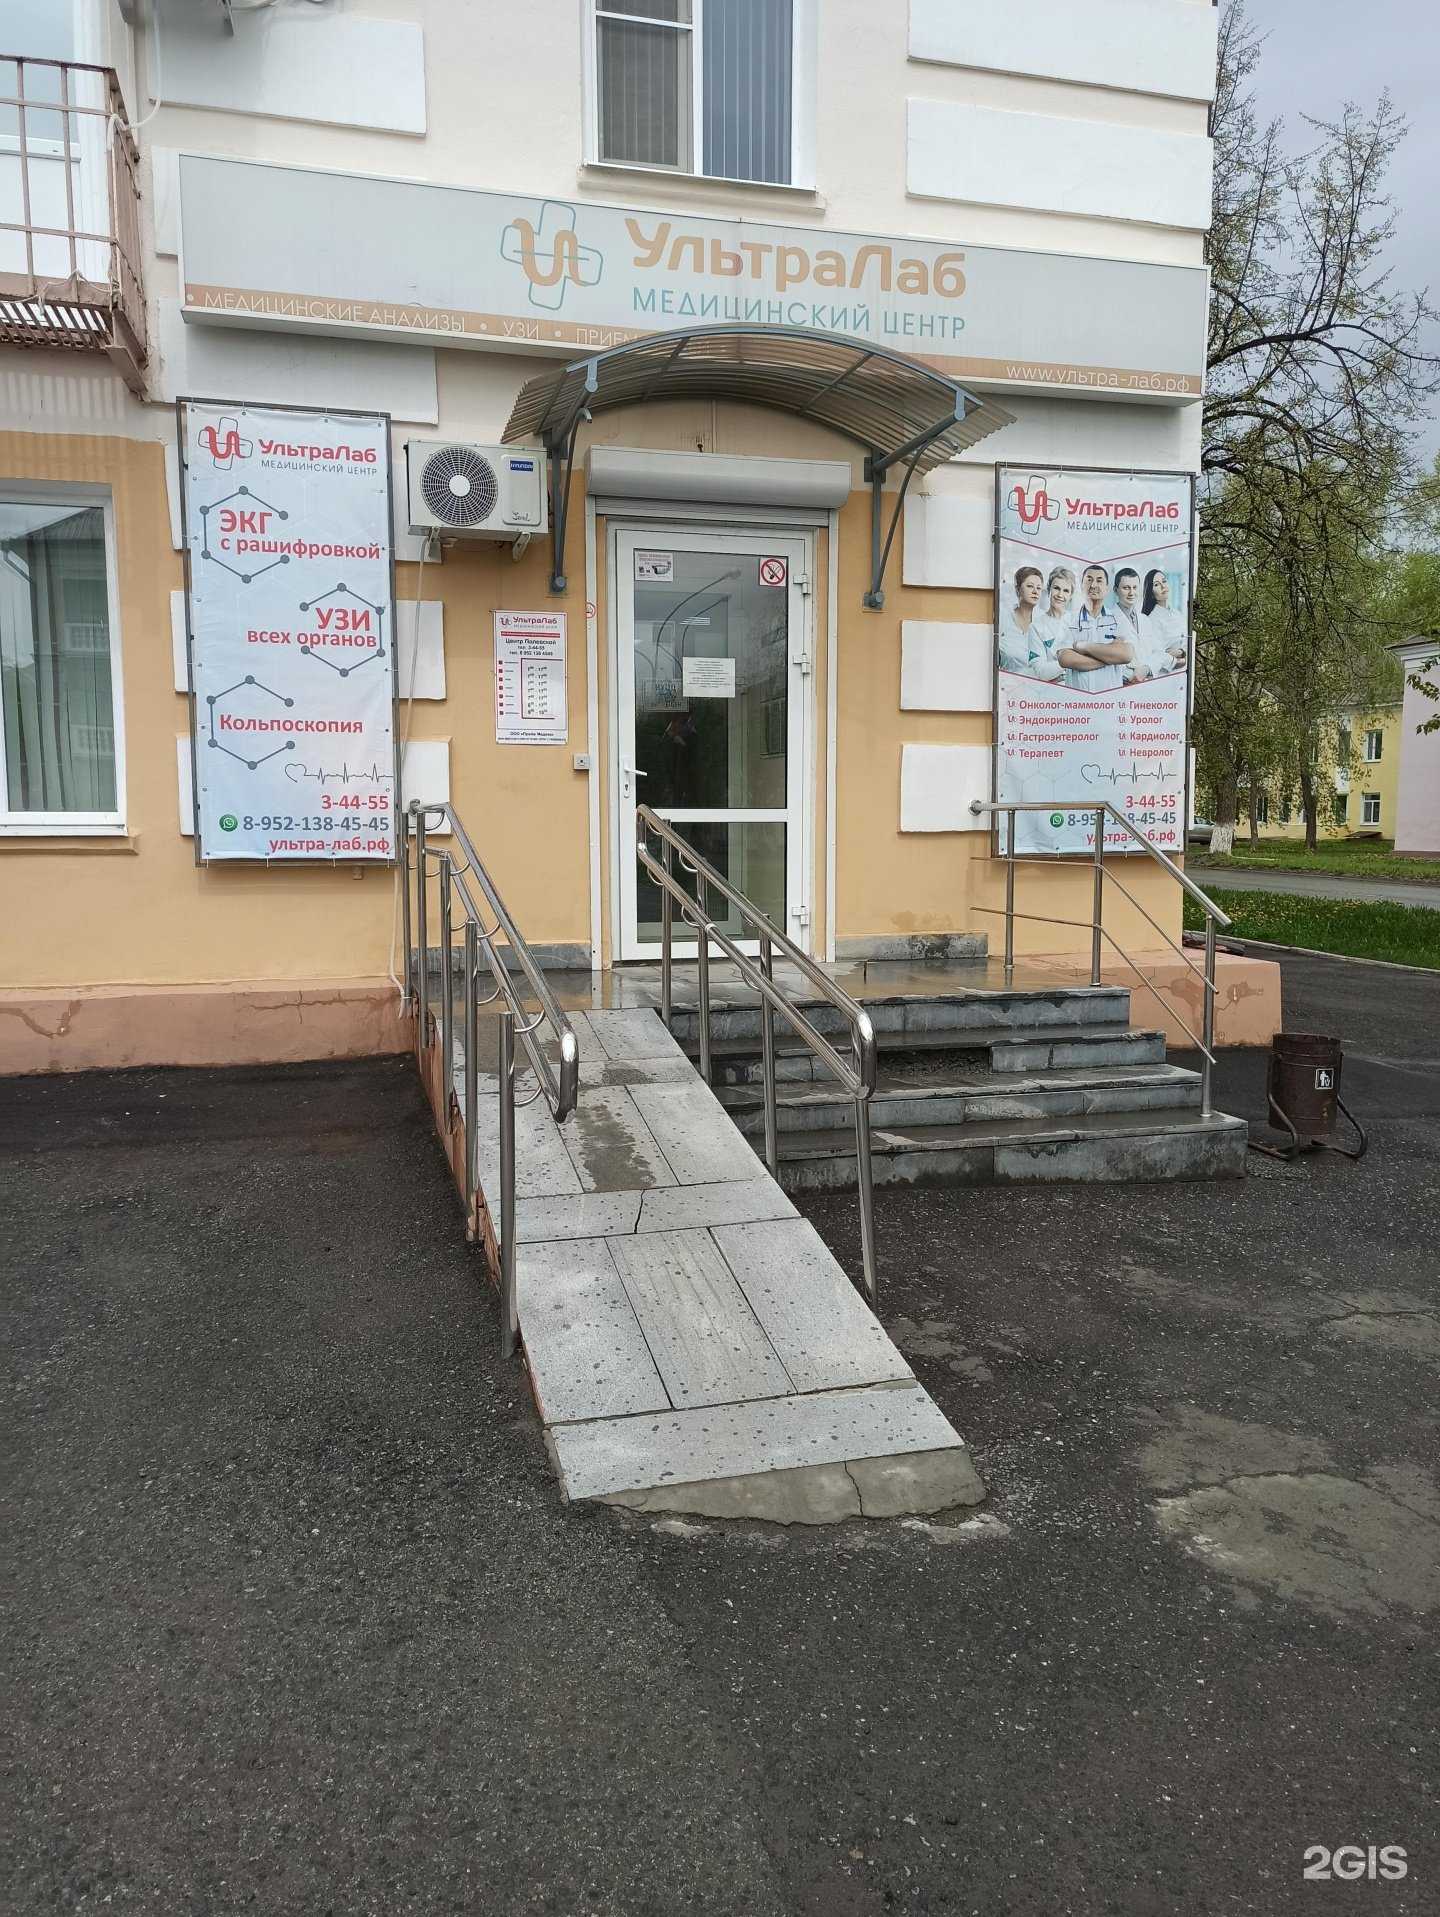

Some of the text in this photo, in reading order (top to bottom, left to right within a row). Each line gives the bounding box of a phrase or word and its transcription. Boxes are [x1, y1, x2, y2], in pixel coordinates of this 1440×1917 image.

[624, 218, 966, 298] УльтраЛаб
[204, 291, 363, 321] МЕДИЦИНСКИЕ
[368, 308, 465, 333] АНАЛИЗЫ
[503, 320, 539, 340] УЗИ
[632, 286, 966, 339] МЕДИЦИНСКИЙ ЦЕНТР
[1006, 364, 1191, 394] www.ультра-лаб.рф
[258, 438, 377, 463] УльтраЛаб
[261, 459, 378, 476] МЕДИЦИНСКИЙ ЦЕНТР
[1065, 497, 1179, 520] УльтраЛаб
[219, 509, 273, 534] ЭКГ
[1067, 520, 1179, 533] МЕДИЦИНСКИЙ ЦЕНТР
[220, 538, 380, 560] с рашифровкой
[315, 607, 371, 632] УЗИ
[247, 630, 377, 648] всех органов
[1019, 700, 1115, 710] Онколог-маммолог
[1129, 700, 1178, 710] Гинеколог
[219, 714, 363, 734] Кольпоскопия
[1019, 715, 1091, 726] Эндокринолог
[1130, 715, 1163, 725] Уролог
[1018, 732, 1099, 743] Гастроэнтеролог
[1130, 731, 1180, 742] Кардиолог
[1019, 749, 1065, 759] Терапевт
[1129, 748, 1174, 759] Невролог
[321, 794, 389, 810] 3-44-55
[1125, 794, 1176, 809] 3-44-55
[242, 815, 390, 832] 8-952-138-45-45
[1067, 812, 1177, 827] 8-95-18-45-45
[269, 837, 390, 853] ультра-лаб.рф
